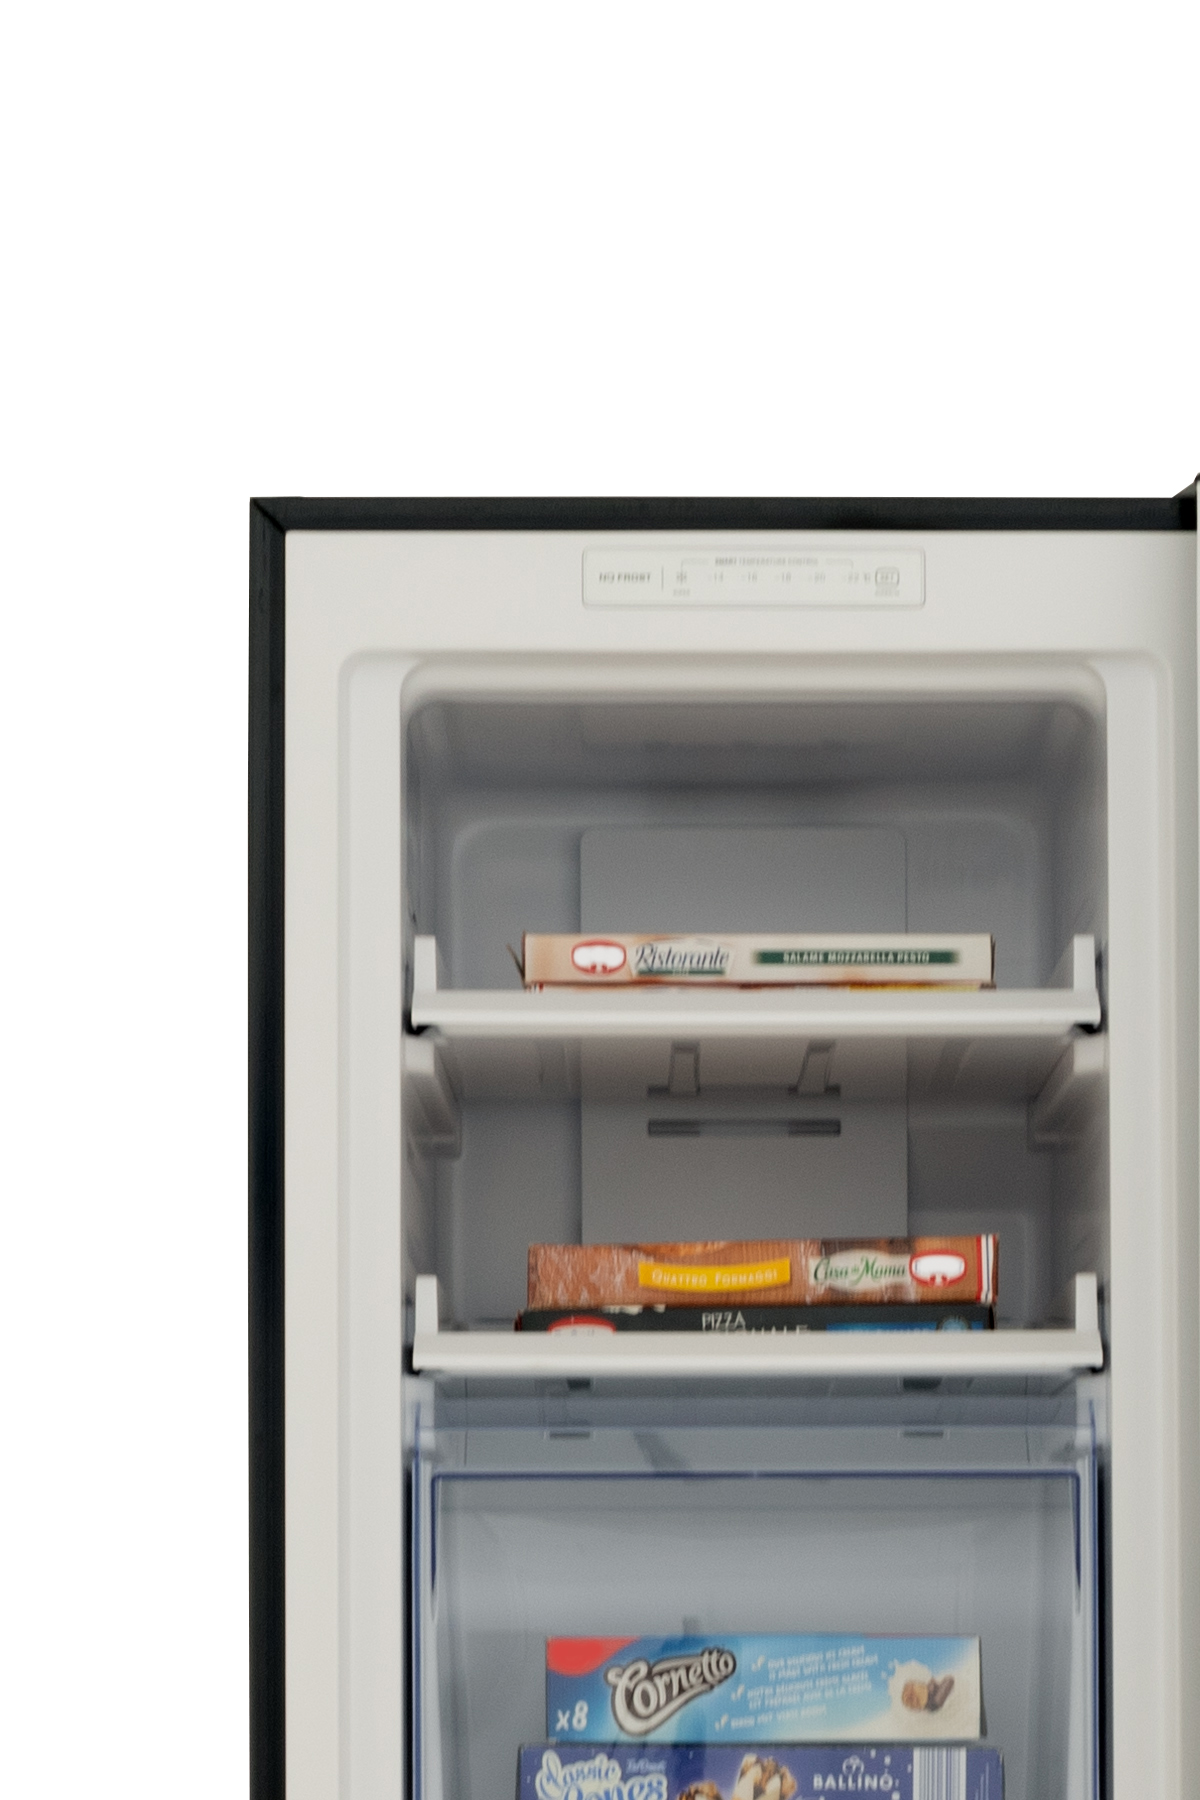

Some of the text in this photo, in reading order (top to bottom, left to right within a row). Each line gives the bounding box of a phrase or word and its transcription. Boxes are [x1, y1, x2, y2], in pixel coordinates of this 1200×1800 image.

[635, 943, 730, 973] Ristorante
[702, 1310, 746, 1331] PIZZA
[605, 1649, 734, 1735] Cornetto
[556, 1701, 588, 1731] x8
